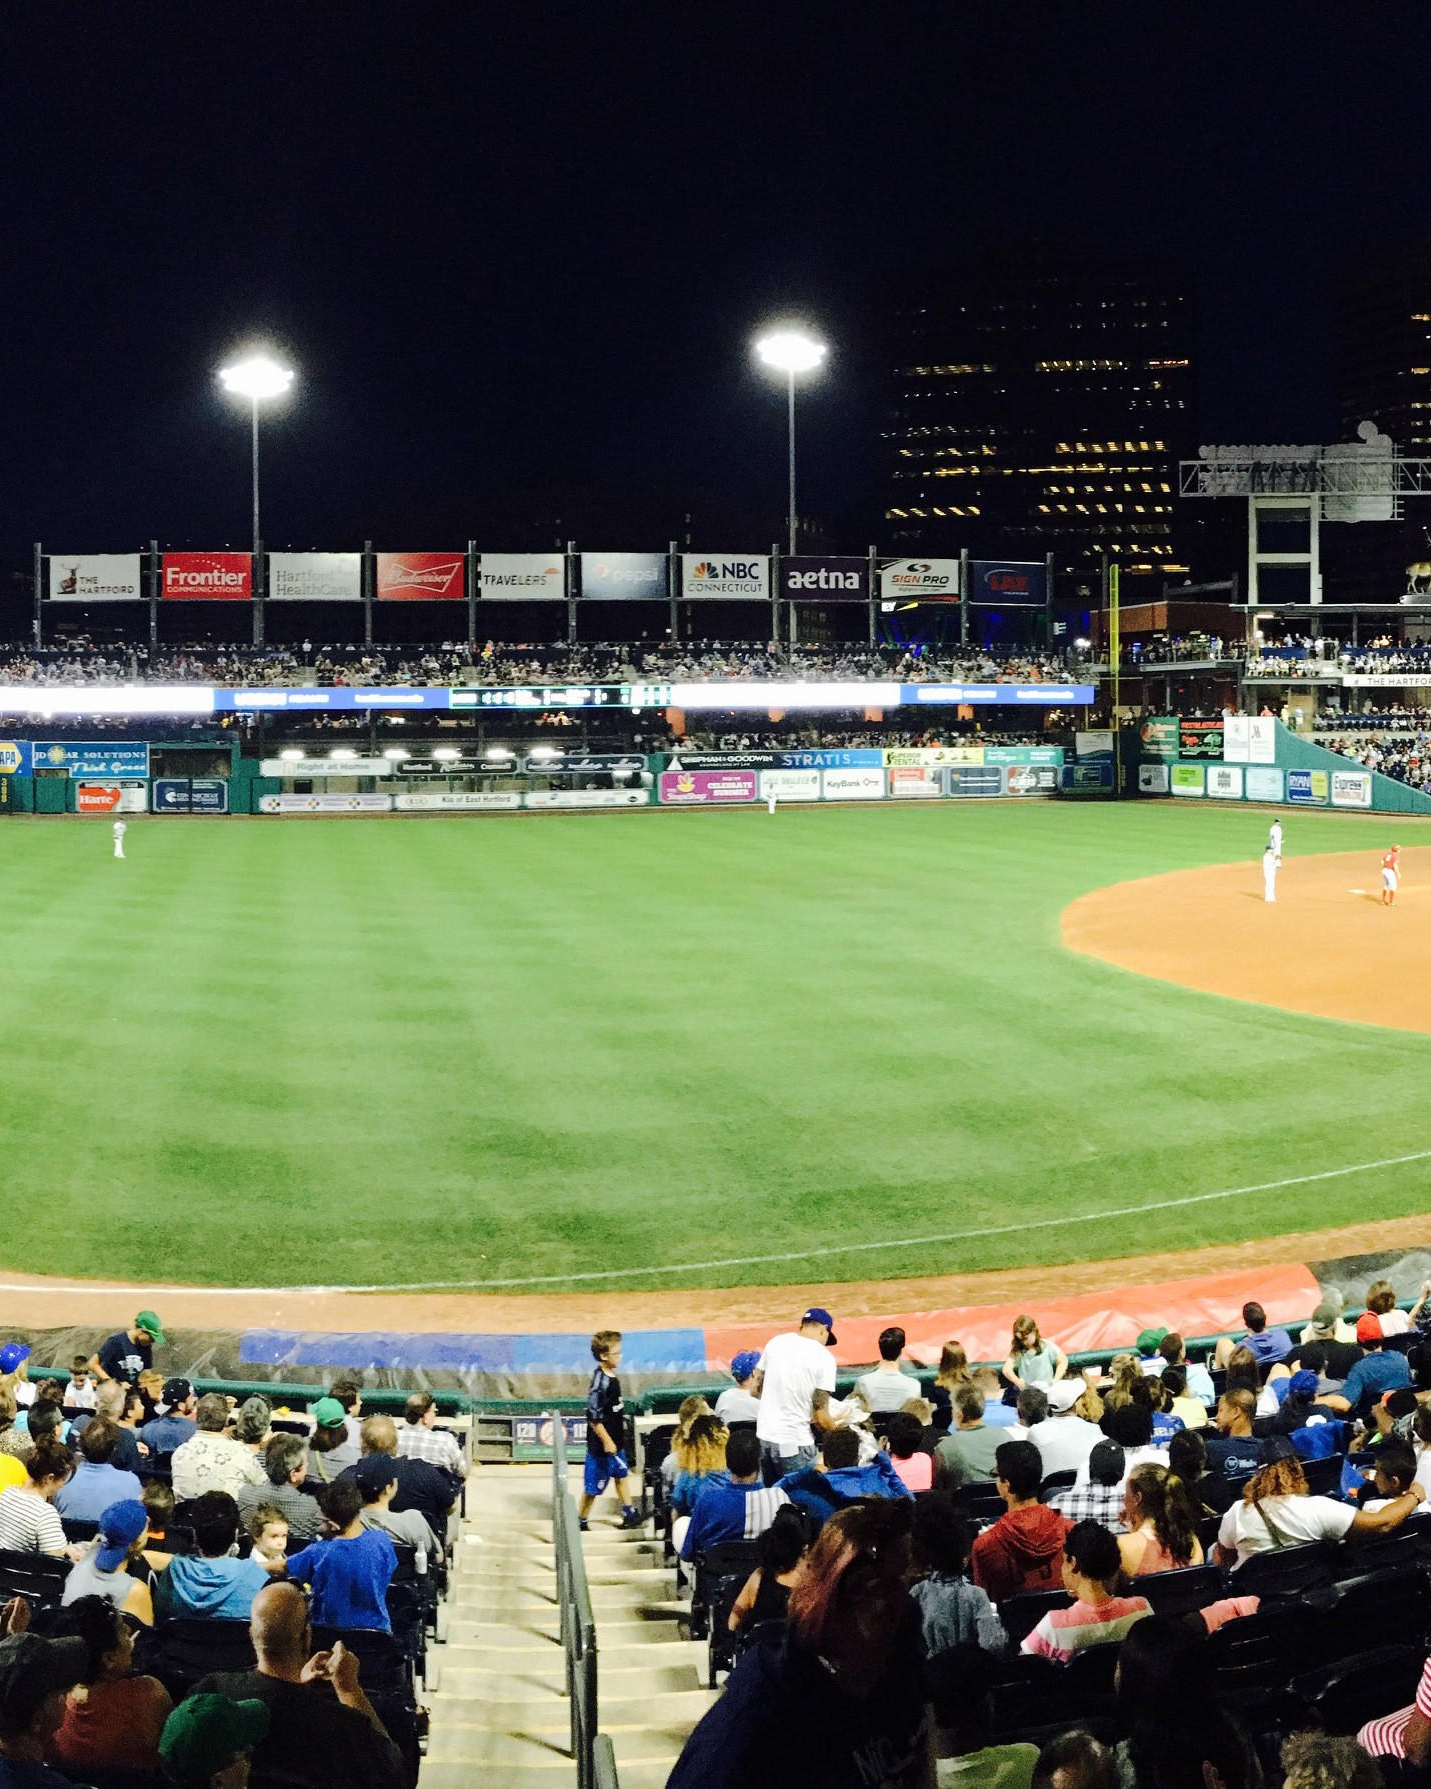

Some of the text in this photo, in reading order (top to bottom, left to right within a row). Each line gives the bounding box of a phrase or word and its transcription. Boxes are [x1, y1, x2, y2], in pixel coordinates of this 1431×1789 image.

[613, 568, 659, 584] pepsi
[722, 562, 759, 580] NBC
[79, 577, 98, 585] THE
[166, 567, 248, 586] Frontier
[483, 574, 546, 586] TRAVELERS
[788, 571, 860, 589] aetna
[891, 575, 950, 584] SIGN PRO
[79, 585, 134, 594] HARTFORD
[687, 583, 763, 593] CONNECTICUT
[1367, 677, 1385, 685] THE
[781, 753, 851, 766] STRATIS
[296, 763, 324, 772] Right
[827, 780, 861, 788] KeyBank
[79, 795, 114, 805] Harte
[482, 794, 511, 803] Hartford
